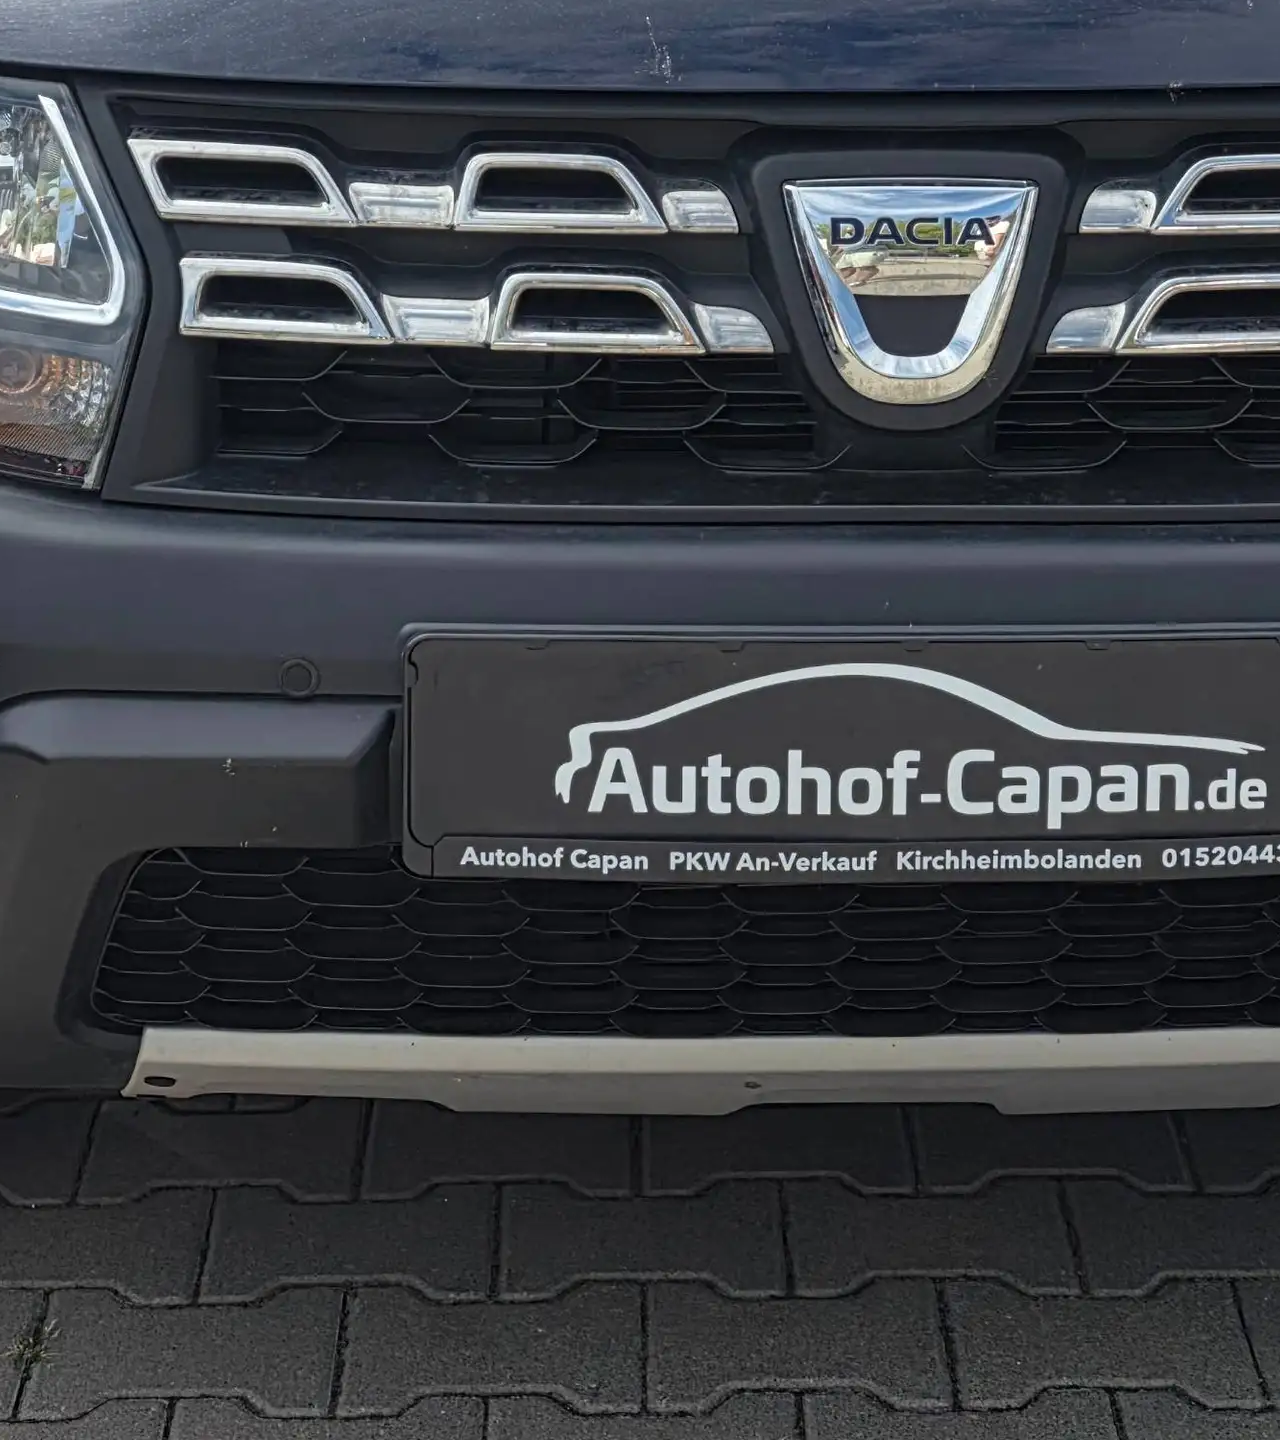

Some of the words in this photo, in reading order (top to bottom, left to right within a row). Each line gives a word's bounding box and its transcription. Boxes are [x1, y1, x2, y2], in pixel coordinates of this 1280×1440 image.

[829, 216, 996, 246] DACIA
[588, 747, 1268, 830] Autohof-Capan.de
[459, 846, 564, 869] Autohof
[570, 848, 649, 875] Capan
[669, 851, 731, 871] PKW
[736, 849, 878, 872] An-Verkauf
[896, 848, 1142, 870] Kirchheimbolanden
